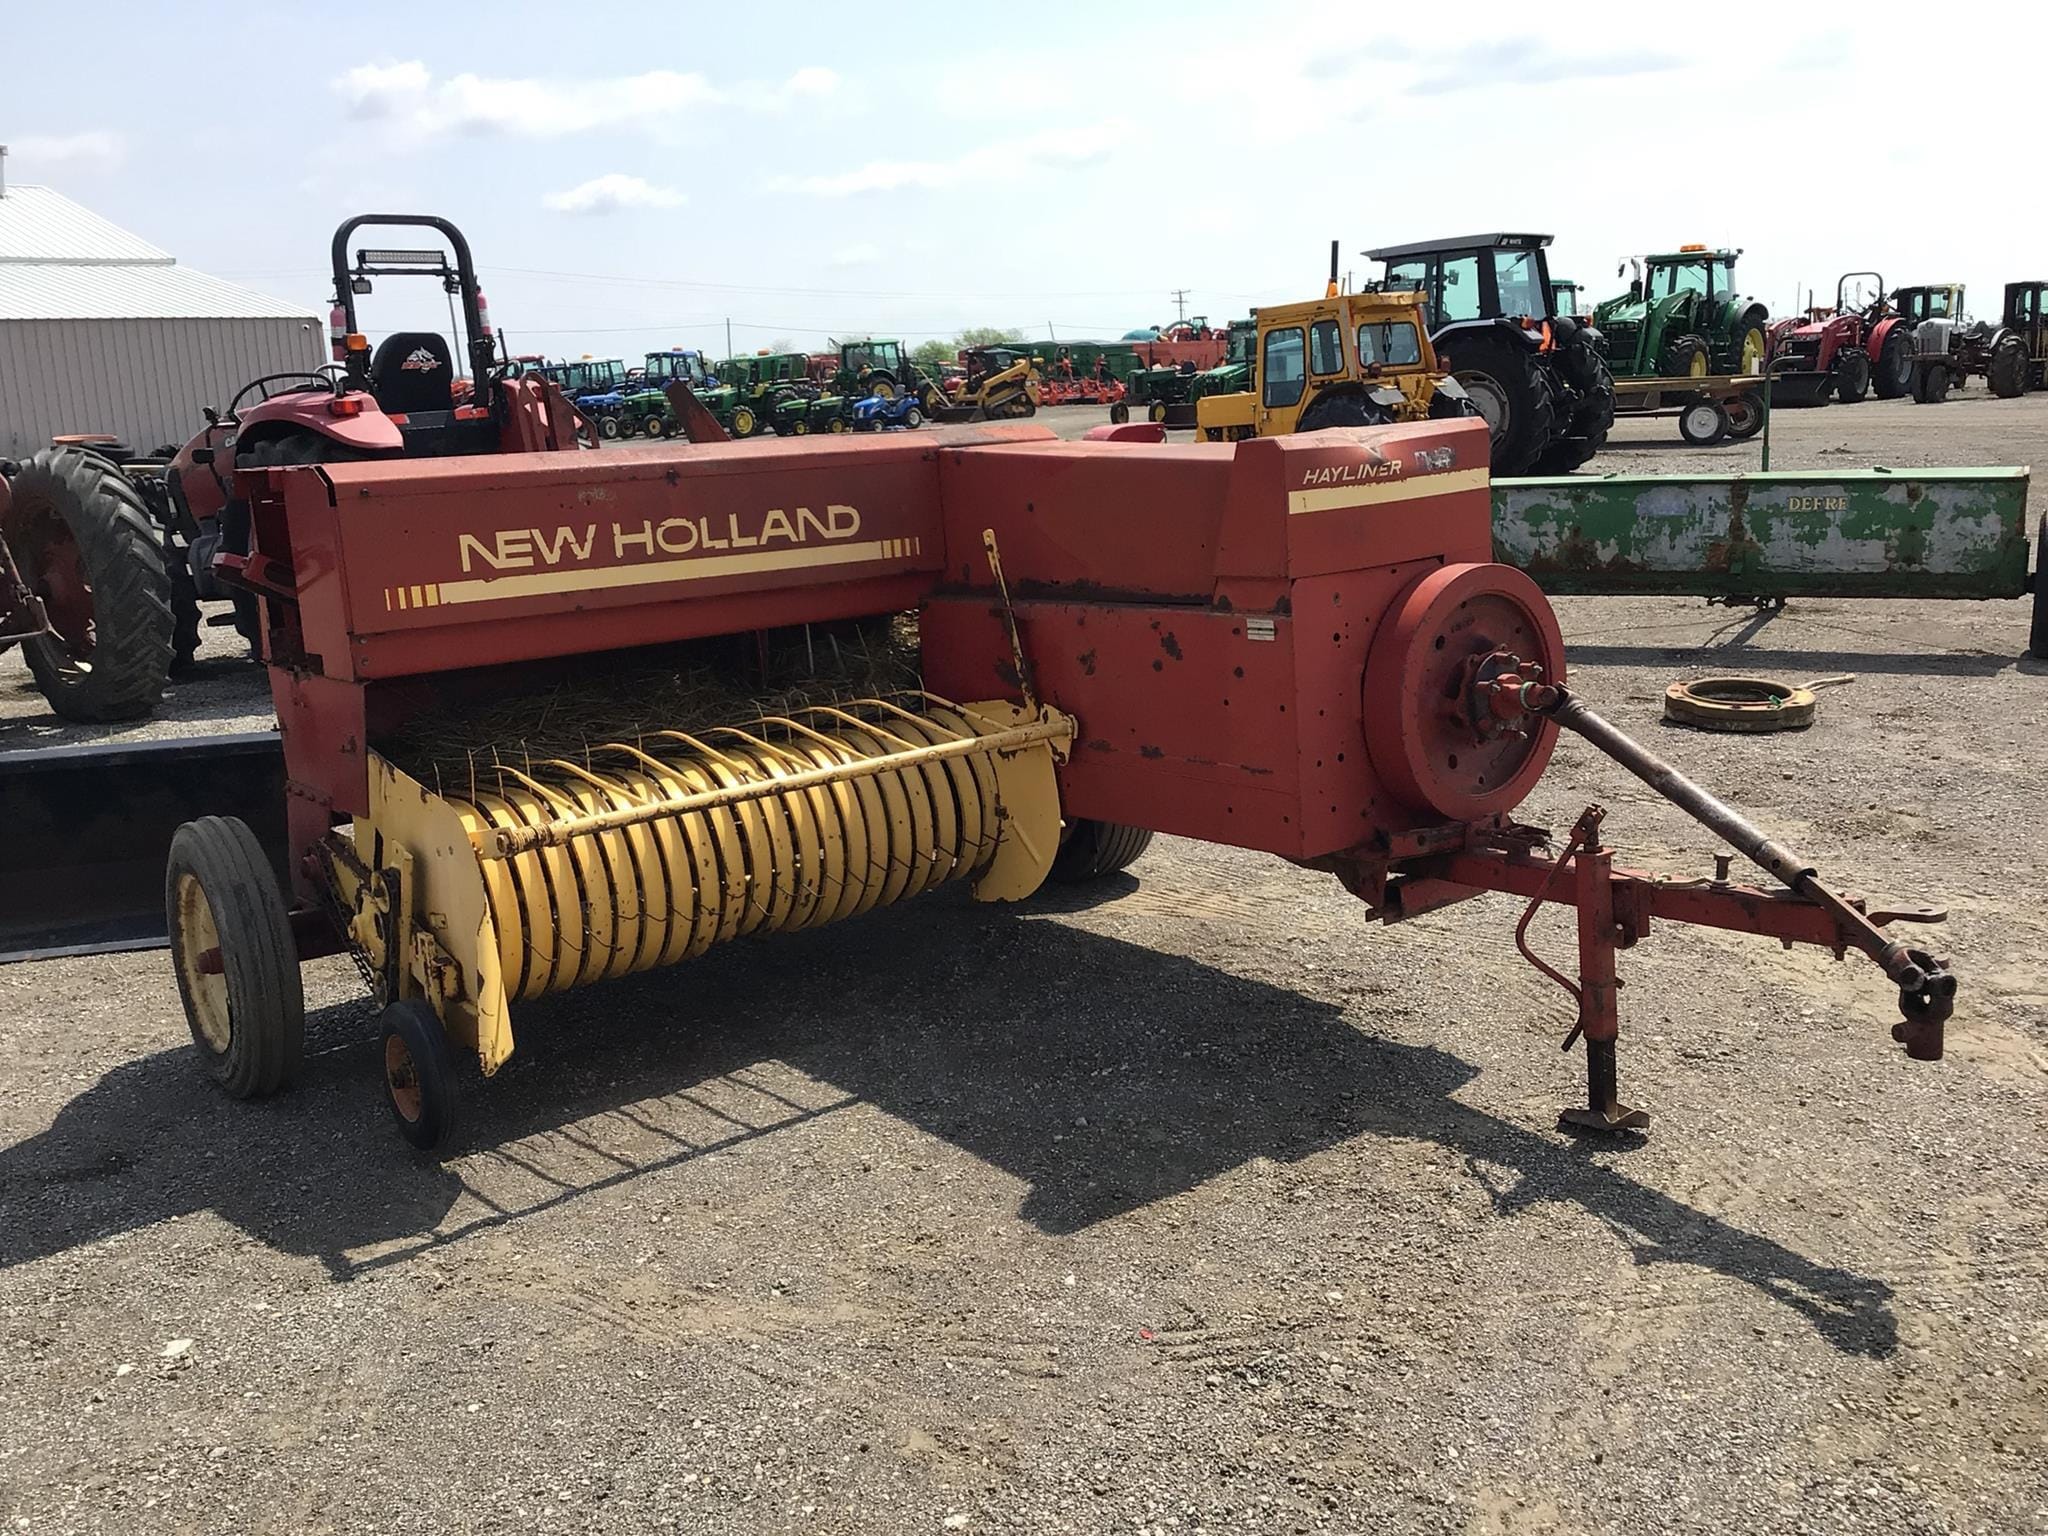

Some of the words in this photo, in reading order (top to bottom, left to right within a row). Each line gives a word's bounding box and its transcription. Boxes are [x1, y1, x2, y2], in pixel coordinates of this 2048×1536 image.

[1302, 460, 1402, 485] HAYLINER
[459, 524, 596, 572] NEW
[612, 505, 861, 558] HOLLAND
